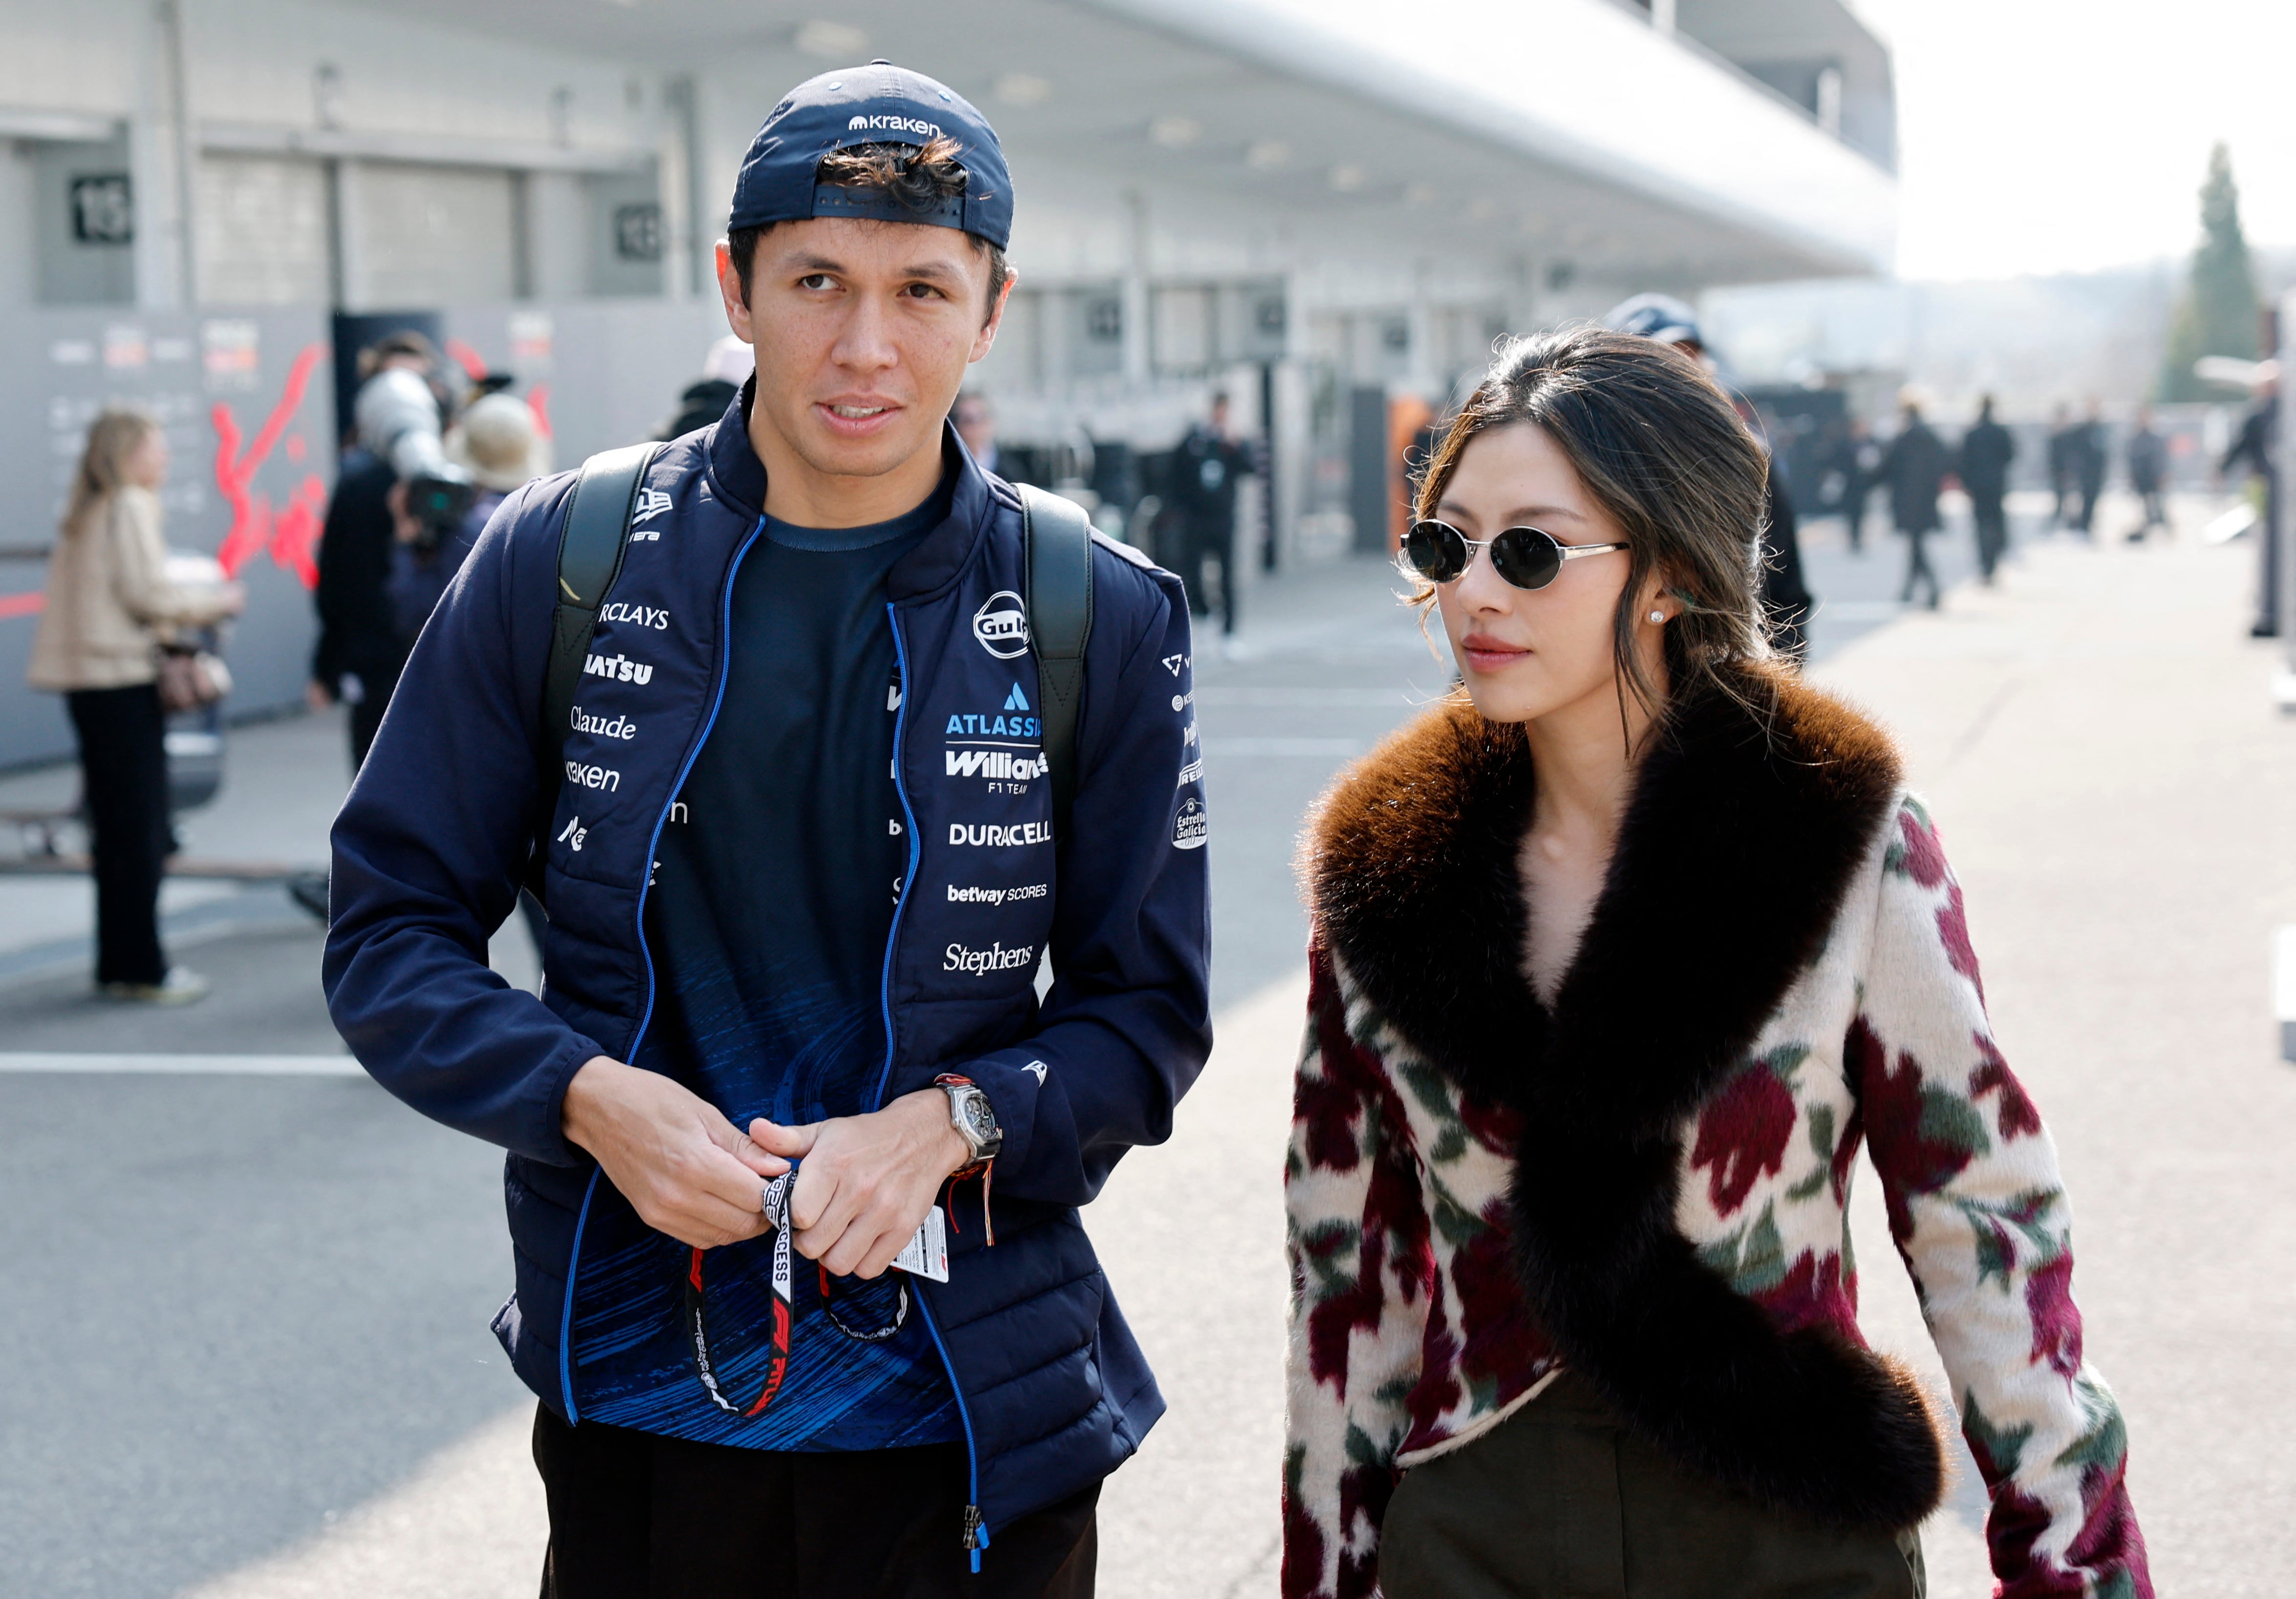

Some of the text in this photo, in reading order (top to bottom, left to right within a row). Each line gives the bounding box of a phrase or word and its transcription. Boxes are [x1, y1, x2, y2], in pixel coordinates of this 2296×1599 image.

[869, 115, 941, 137] kraken
[599, 603, 669, 630] RCLAYS
[571, 705, 637, 740] Claude
[945, 714, 1042, 737] ATLASSI
[988, 782, 1002, 794] F1
[949, 820, 1051, 847] DURACELL
[1177, 824, 1206, 839] Galicia
[947, 883, 1048, 907] betway SCORES
[943, 941, 1033, 976] Stephens
